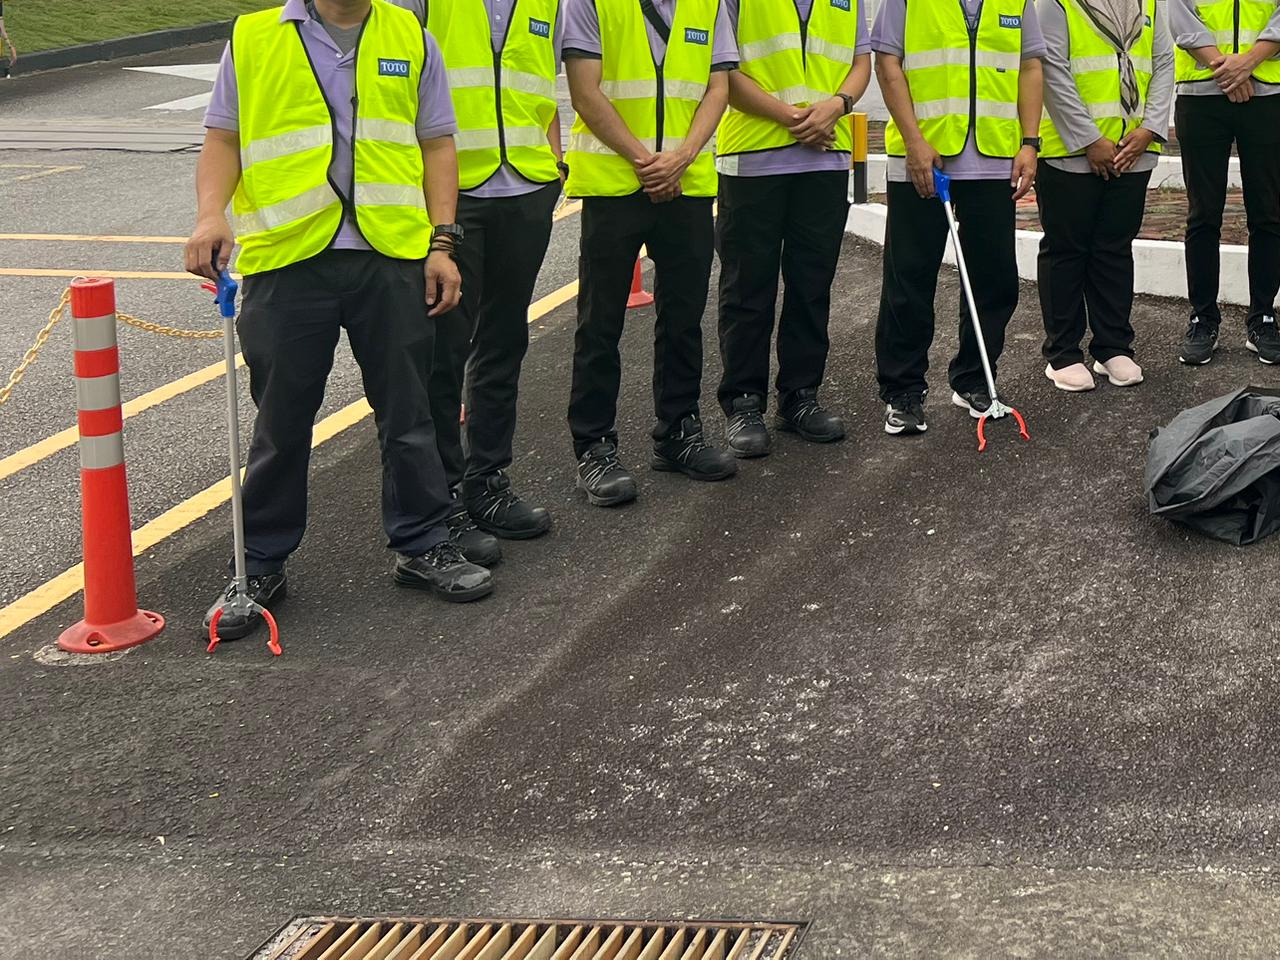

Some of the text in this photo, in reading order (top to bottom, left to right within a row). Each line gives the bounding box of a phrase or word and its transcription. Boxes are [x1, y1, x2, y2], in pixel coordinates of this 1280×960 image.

[1000, 16, 1019, 26] TOTO
[686, 30, 707, 41] TOTO
[381, 61, 407, 73] TOTO
